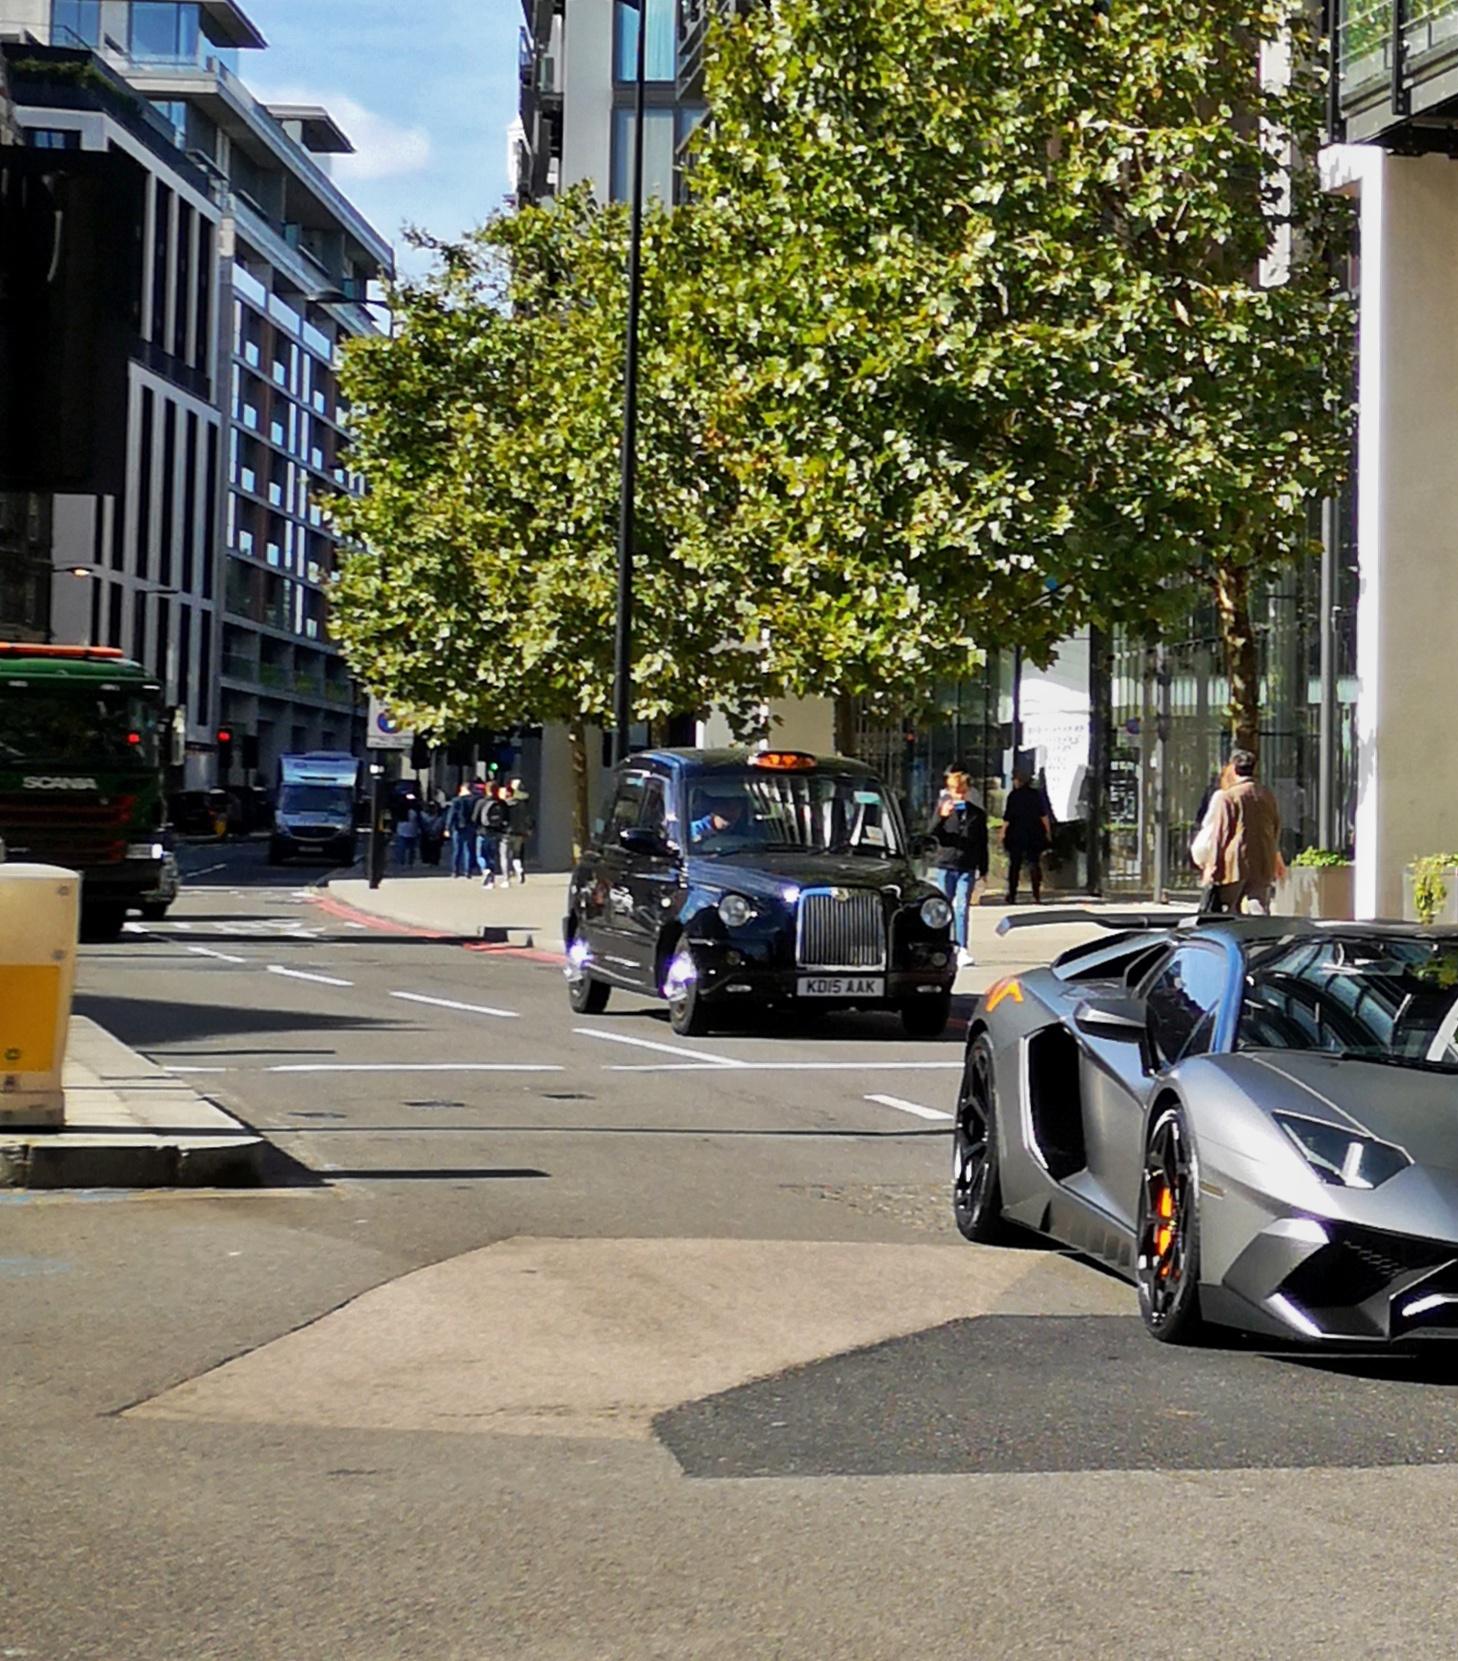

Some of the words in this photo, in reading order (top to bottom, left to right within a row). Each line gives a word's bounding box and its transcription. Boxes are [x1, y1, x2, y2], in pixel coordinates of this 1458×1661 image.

[23, 776, 97, 789] SCANIA
[806, 979, 842, 993] KD15
[846, 979, 876, 993] AAK
